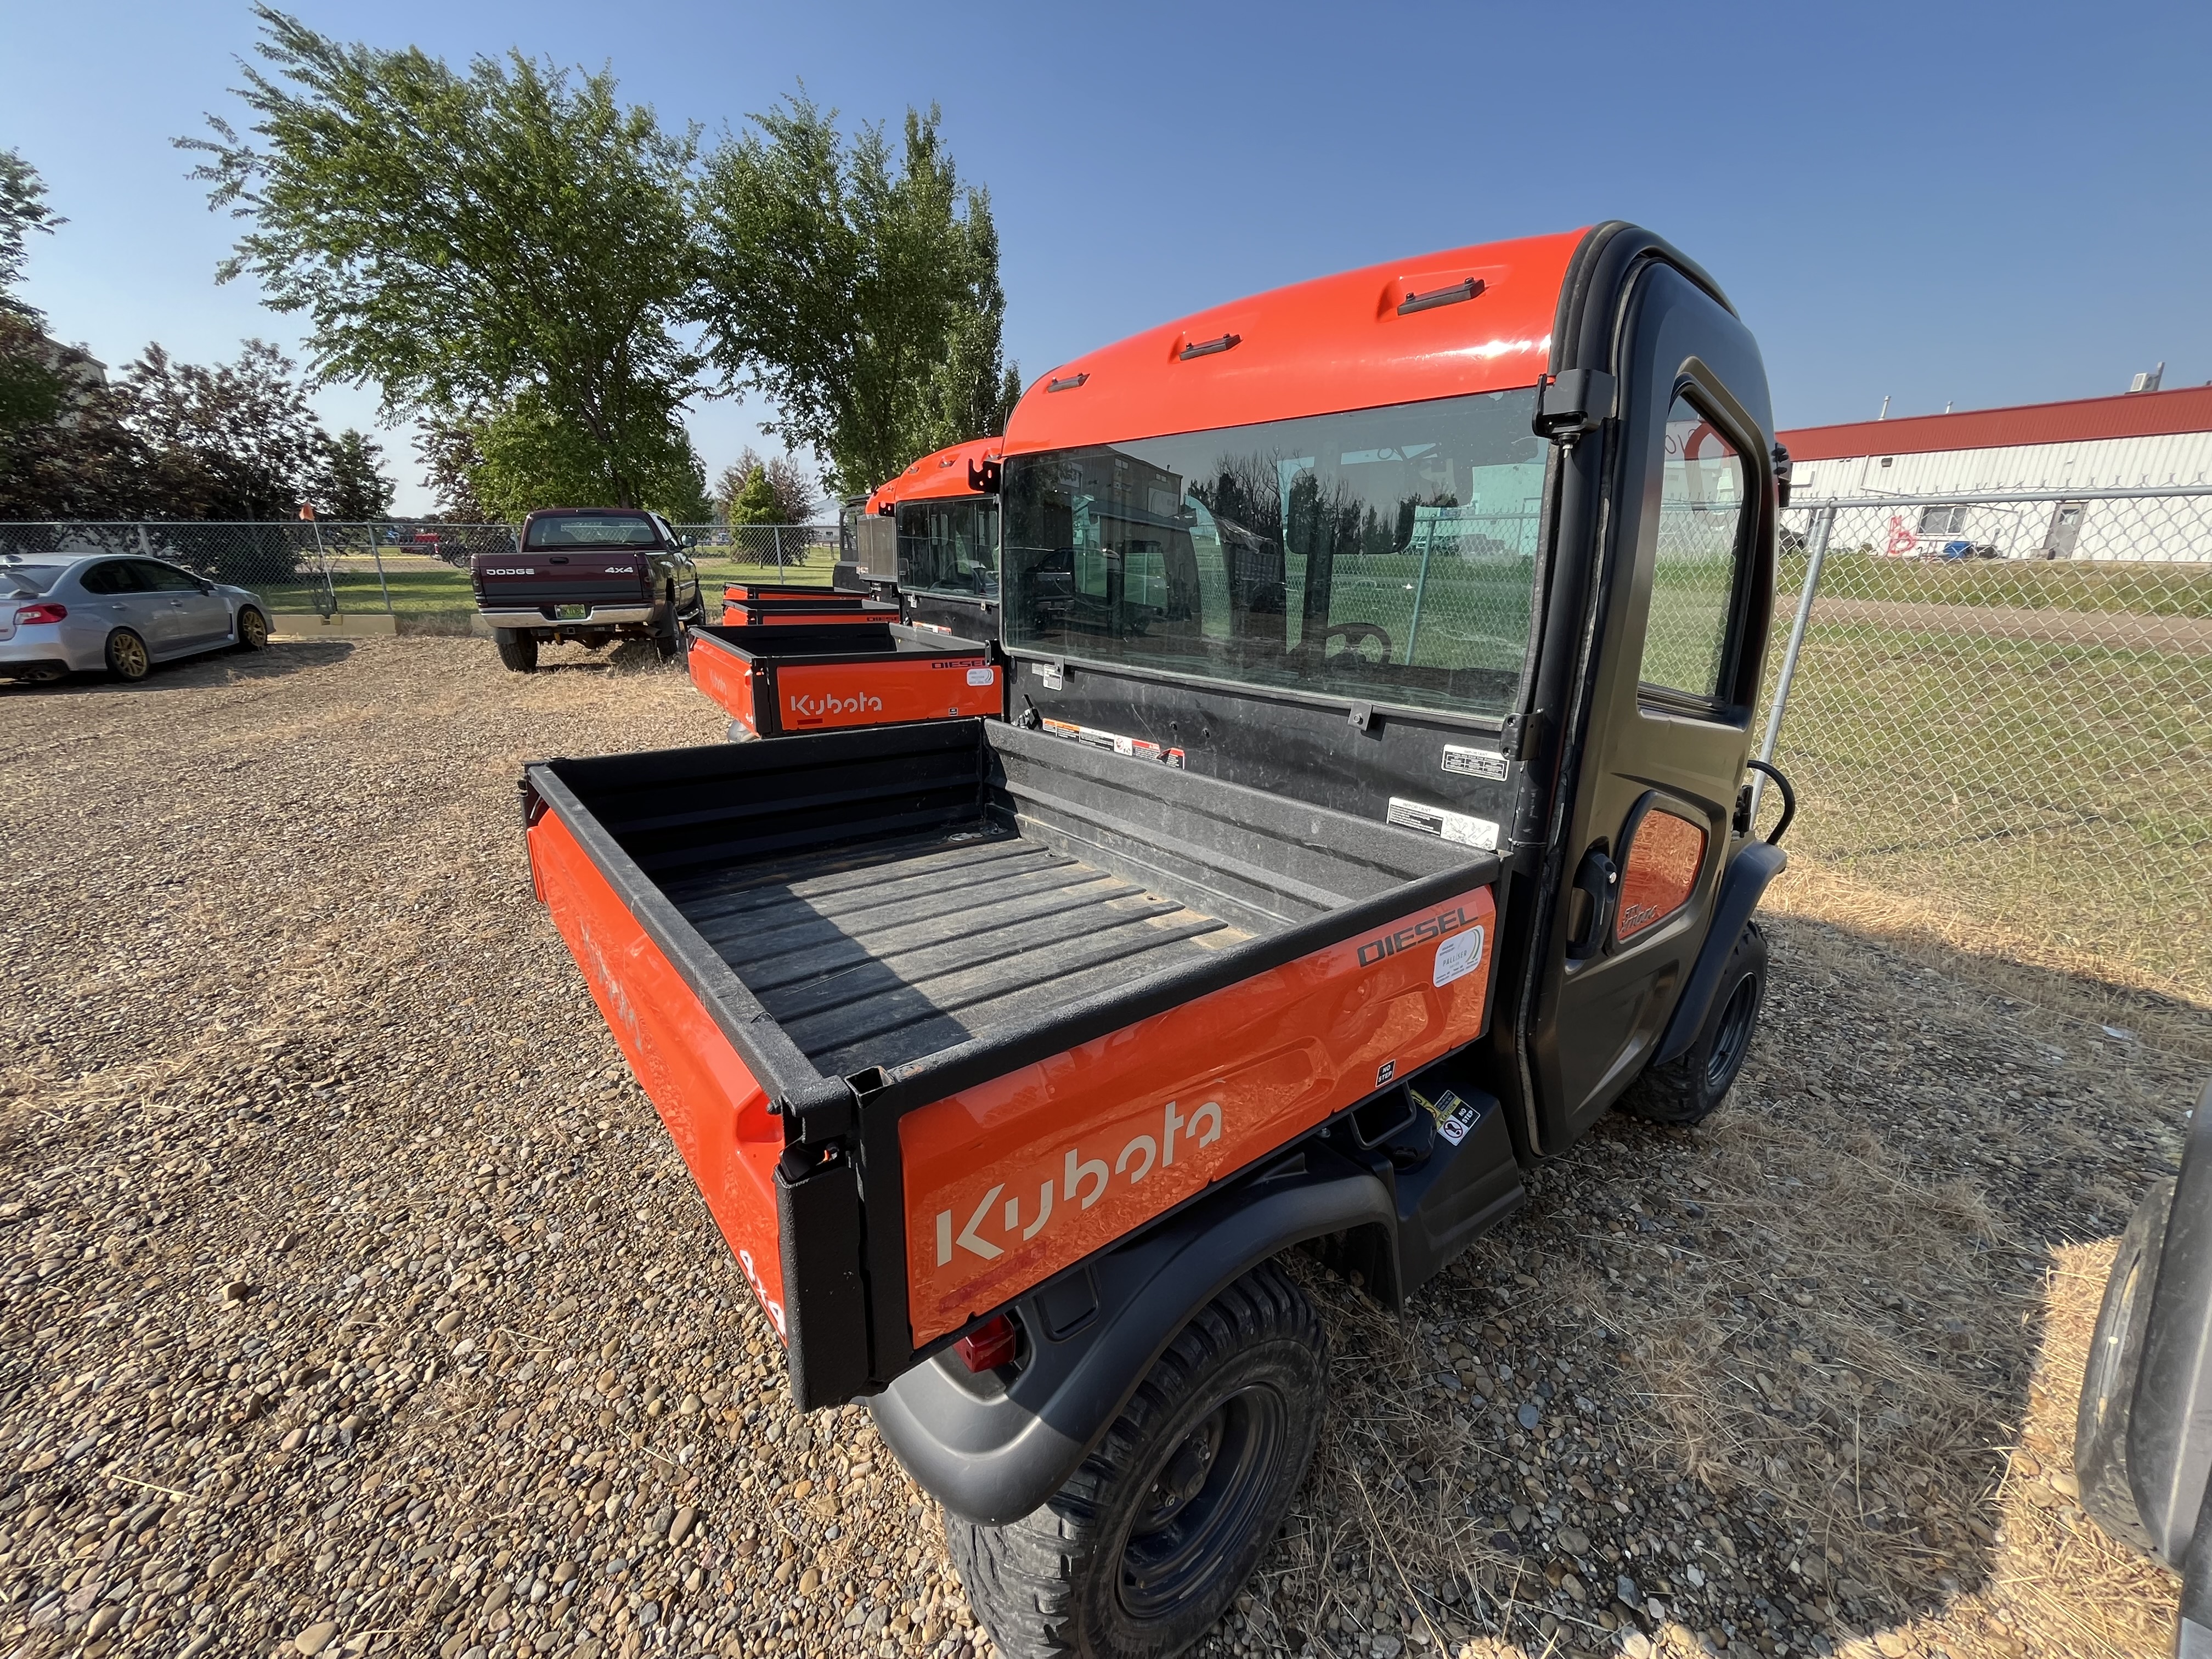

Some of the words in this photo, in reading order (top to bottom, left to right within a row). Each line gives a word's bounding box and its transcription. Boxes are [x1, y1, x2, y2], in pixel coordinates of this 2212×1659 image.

[791, 692, 882, 716] Kubota
[1402, 803, 1431, 812] IMPORTANT
[1357, 907, 1479, 968] DIESEL
[1382, 1065, 1391, 1074] NO
[1378, 1070, 1392, 1083] STEP
[1458, 1108, 1468, 1117] NO
[1462, 1110, 1474, 1124] STEP
[936, 1101, 1222, 1267] Kubota
